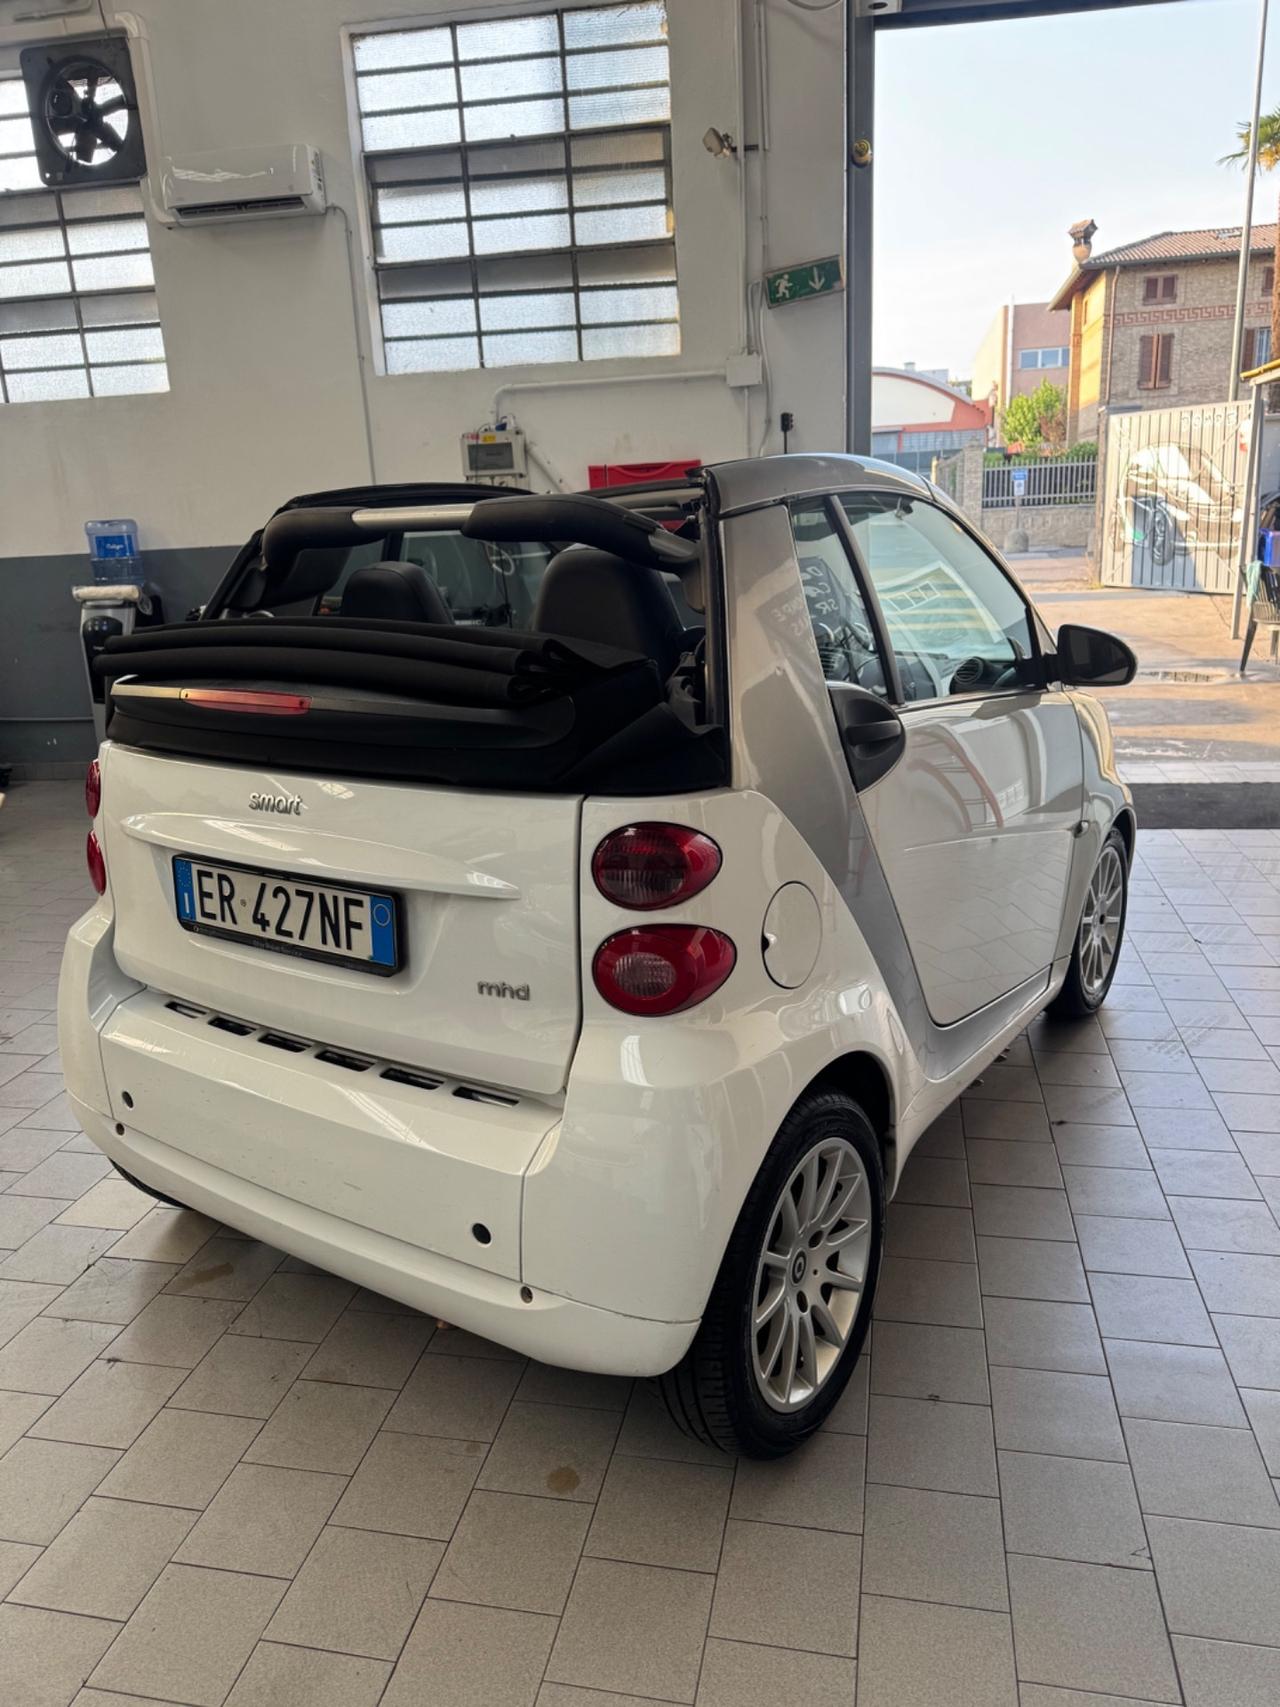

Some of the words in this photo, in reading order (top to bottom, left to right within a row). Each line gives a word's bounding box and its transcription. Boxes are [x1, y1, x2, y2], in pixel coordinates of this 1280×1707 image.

[248, 792, 303, 816] smart
[196, 868, 238, 925] ER
[252, 882, 364, 950] 427NF
[477, 980, 530, 1001] mhd
